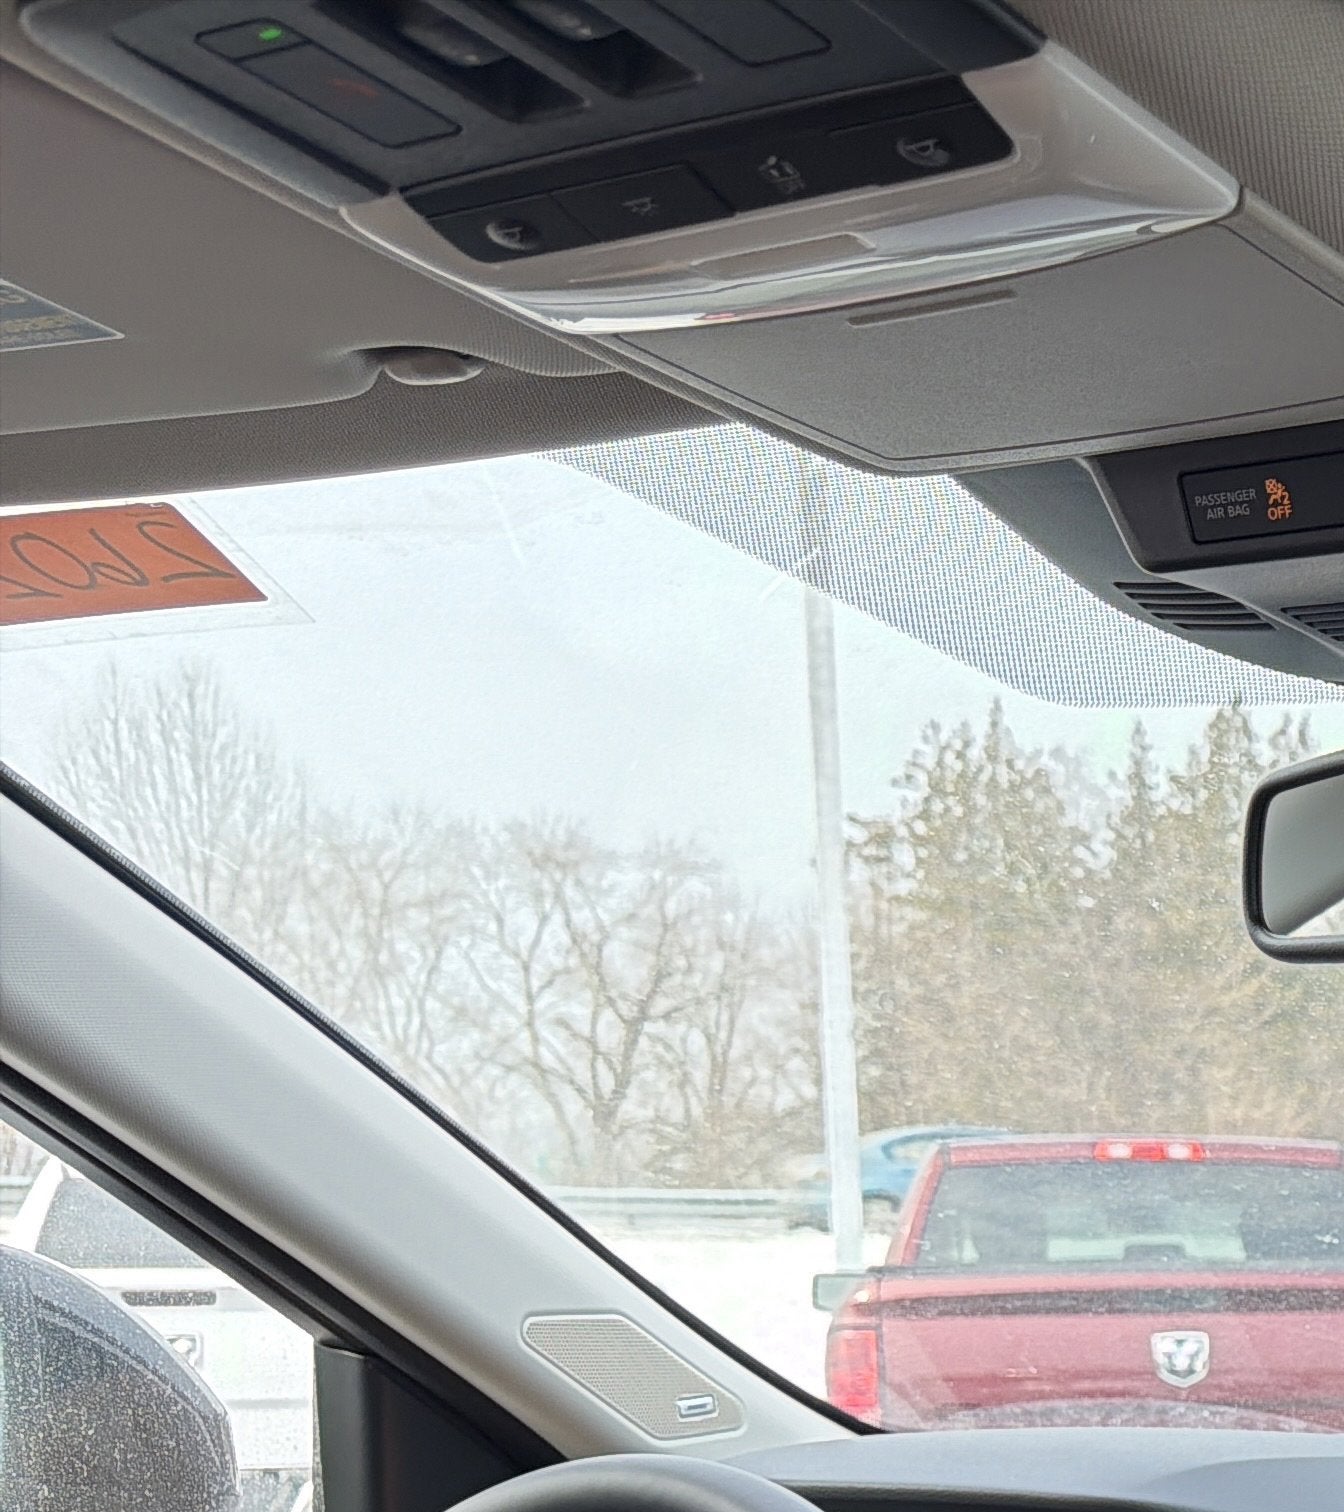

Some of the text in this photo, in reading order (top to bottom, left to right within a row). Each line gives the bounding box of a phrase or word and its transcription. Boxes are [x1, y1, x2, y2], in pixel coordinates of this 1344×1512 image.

[1194, 488, 1257, 507] PASSENGER
[1206, 503, 1250, 520] AIR BAG
[1267, 504, 1293, 521] OFF
